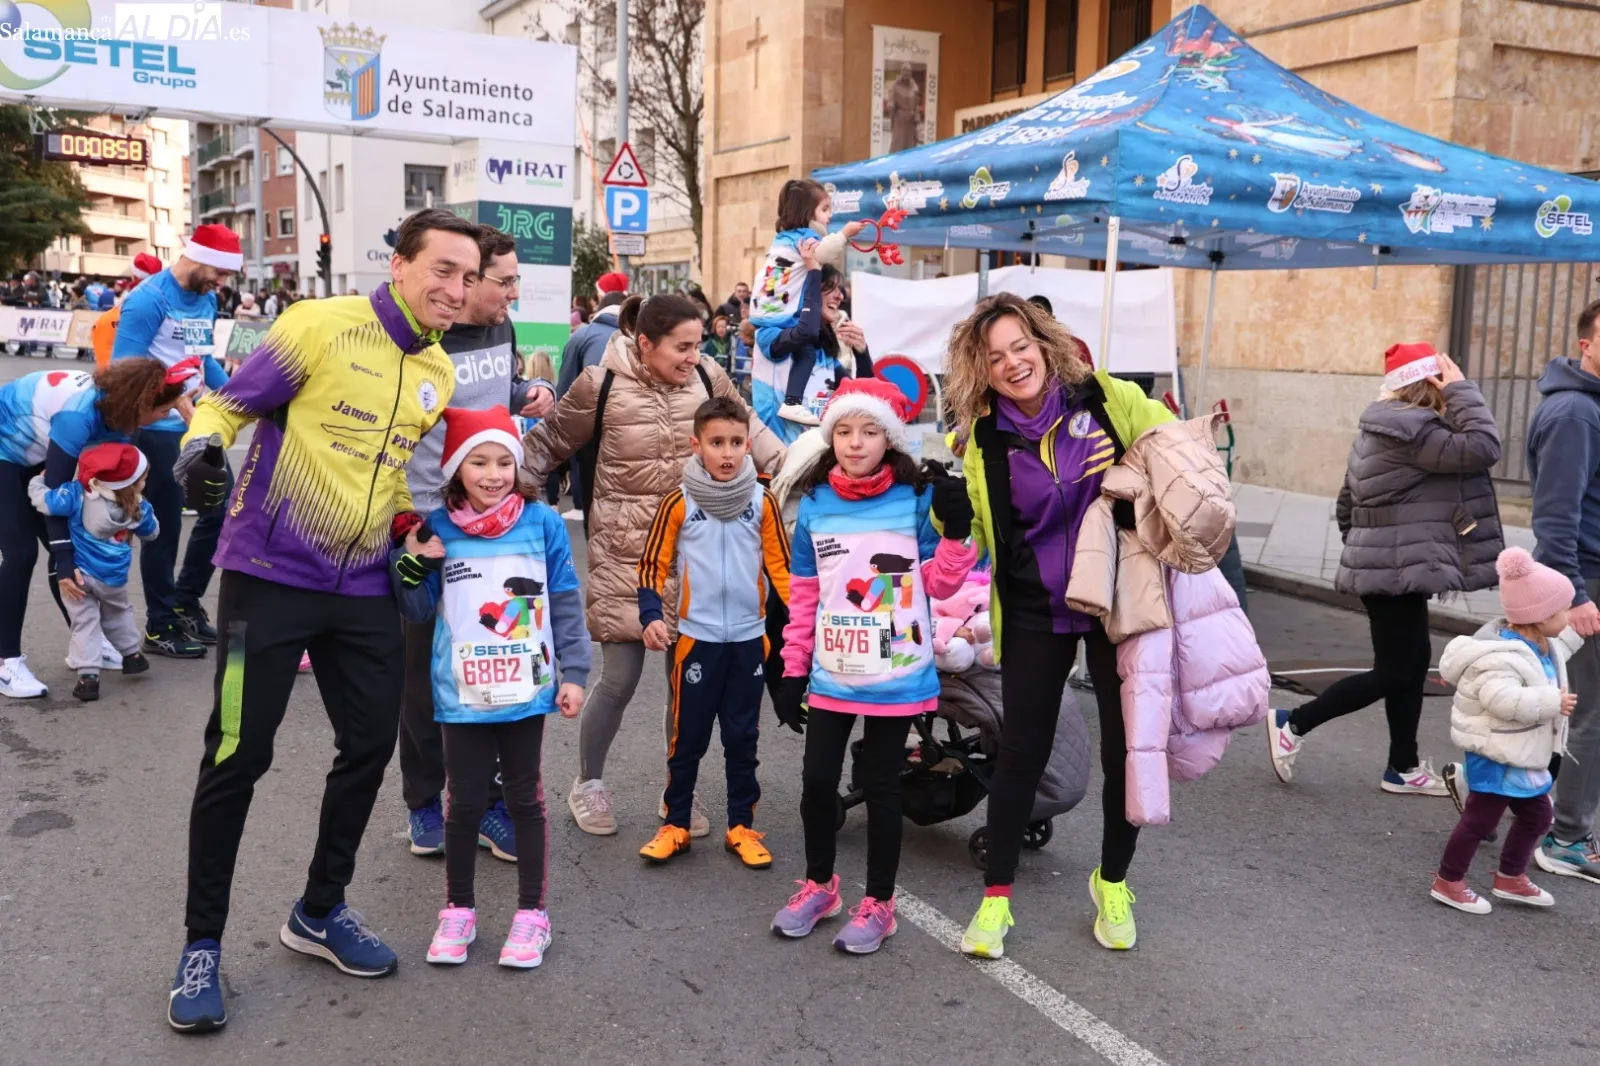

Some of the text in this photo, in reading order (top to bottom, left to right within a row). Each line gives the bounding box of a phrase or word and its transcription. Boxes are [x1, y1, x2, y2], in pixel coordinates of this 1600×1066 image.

[24, 30, 196, 75] SETEL
[133, 71, 197, 89] Grupo
[387, 69, 534, 102] Ayuntamiento
[387, 95, 534, 127] de Salamanca
[613, 190, 641, 228] P
[1546, 212, 1592, 227] SETEL
[331, 400, 379, 425] Jamón
[330, 441, 370, 462] Atletismo
[831, 615, 882, 627] SETEL
[474, 643, 532, 657] SETEL
[823, 628, 869, 654] 6476
[462, 657, 522, 687] 6862
